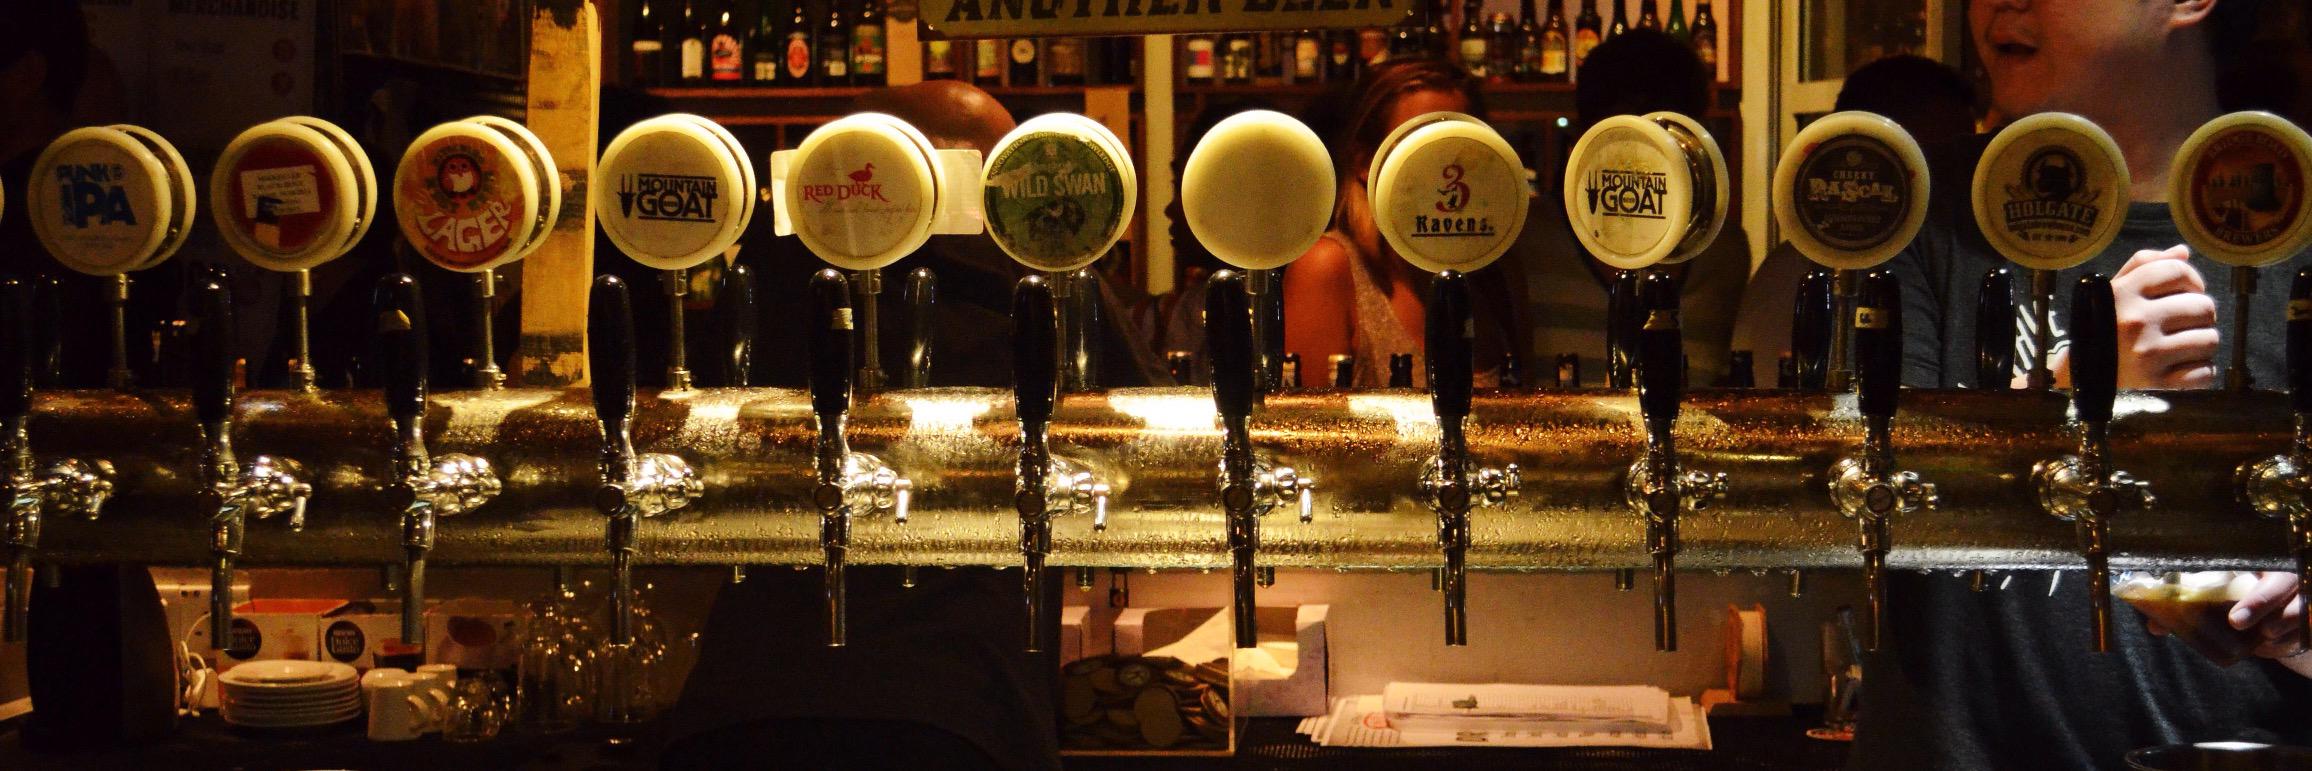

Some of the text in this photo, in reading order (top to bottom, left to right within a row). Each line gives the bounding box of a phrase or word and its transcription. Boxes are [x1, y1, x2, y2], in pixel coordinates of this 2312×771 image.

[638, 178, 717, 194] MOUNTAIN
[803, 183, 890, 203] RED DUCK
[1001, 168, 1106, 199] WILD SWAN
[1435, 164, 1470, 213] 3
[1602, 173, 1667, 192] MOUNTAIN
[62, 181, 137, 228] IPA
[636, 190, 718, 219] GOAT
[1600, 188, 1668, 215] GOAT
[2007, 199, 2096, 225] HOLGATE
[416, 201, 513, 252] LAGER
[2214, 221, 2280, 244] BREWERS
